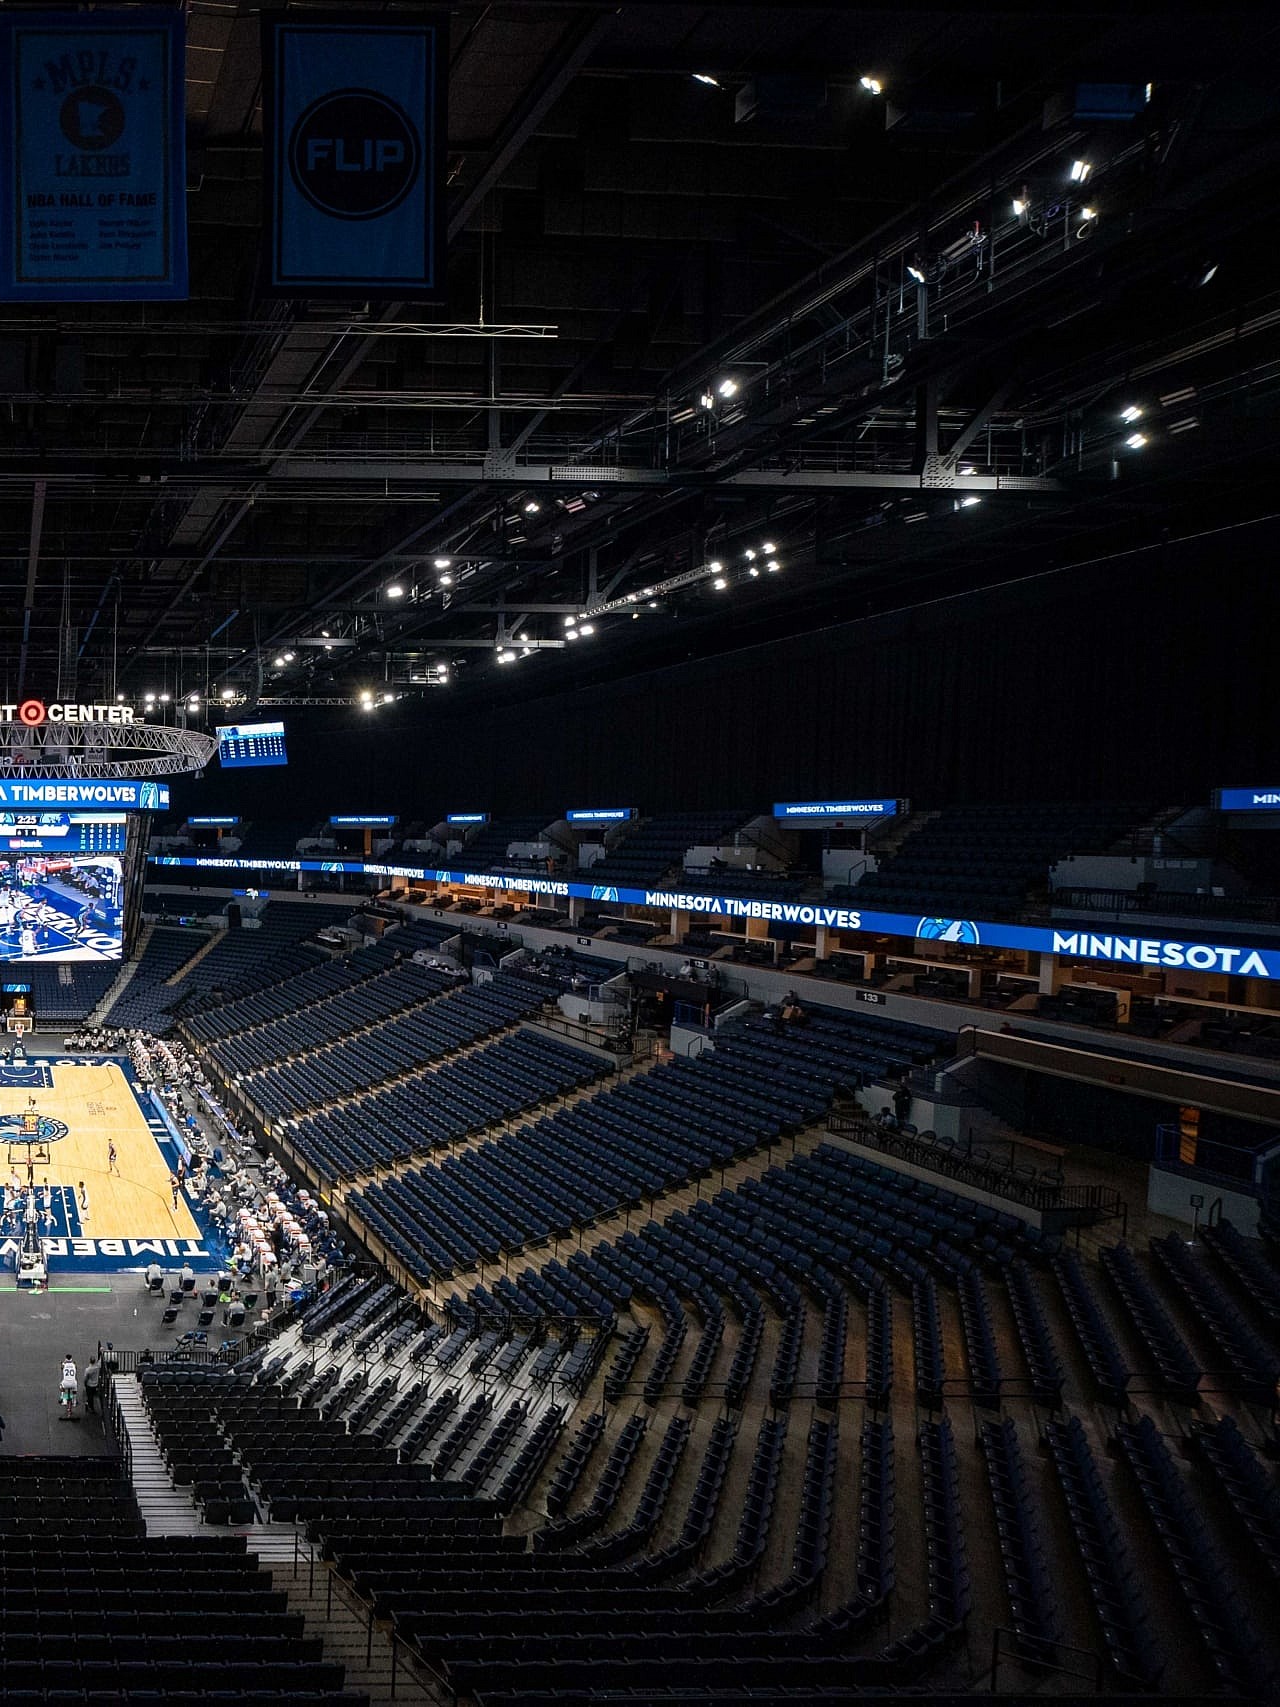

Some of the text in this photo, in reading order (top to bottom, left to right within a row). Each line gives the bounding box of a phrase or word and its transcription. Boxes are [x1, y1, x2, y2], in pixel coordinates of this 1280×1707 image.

[44, 50, 137, 94] MPLS
[306, 138, 406, 172] FLIP
[27, 193, 157, 208] NBA HALL OF FAME
[48, 704, 135, 724] CENTER
[11, 785, 136, 801] TIMBERWOLVES
[17, 815, 37, 825] 2:25
[196, 858, 301, 870] MINNESOTA TIMBERWOLVES
[464, 874, 568, 895] MINNESOTA TIMBERWOLVES
[646, 891, 861, 929] MINNESOTA TIMBERWOLVES
[1053, 931, 1269, 976] MINNESOTA
[863, 993, 878, 1002] 133
